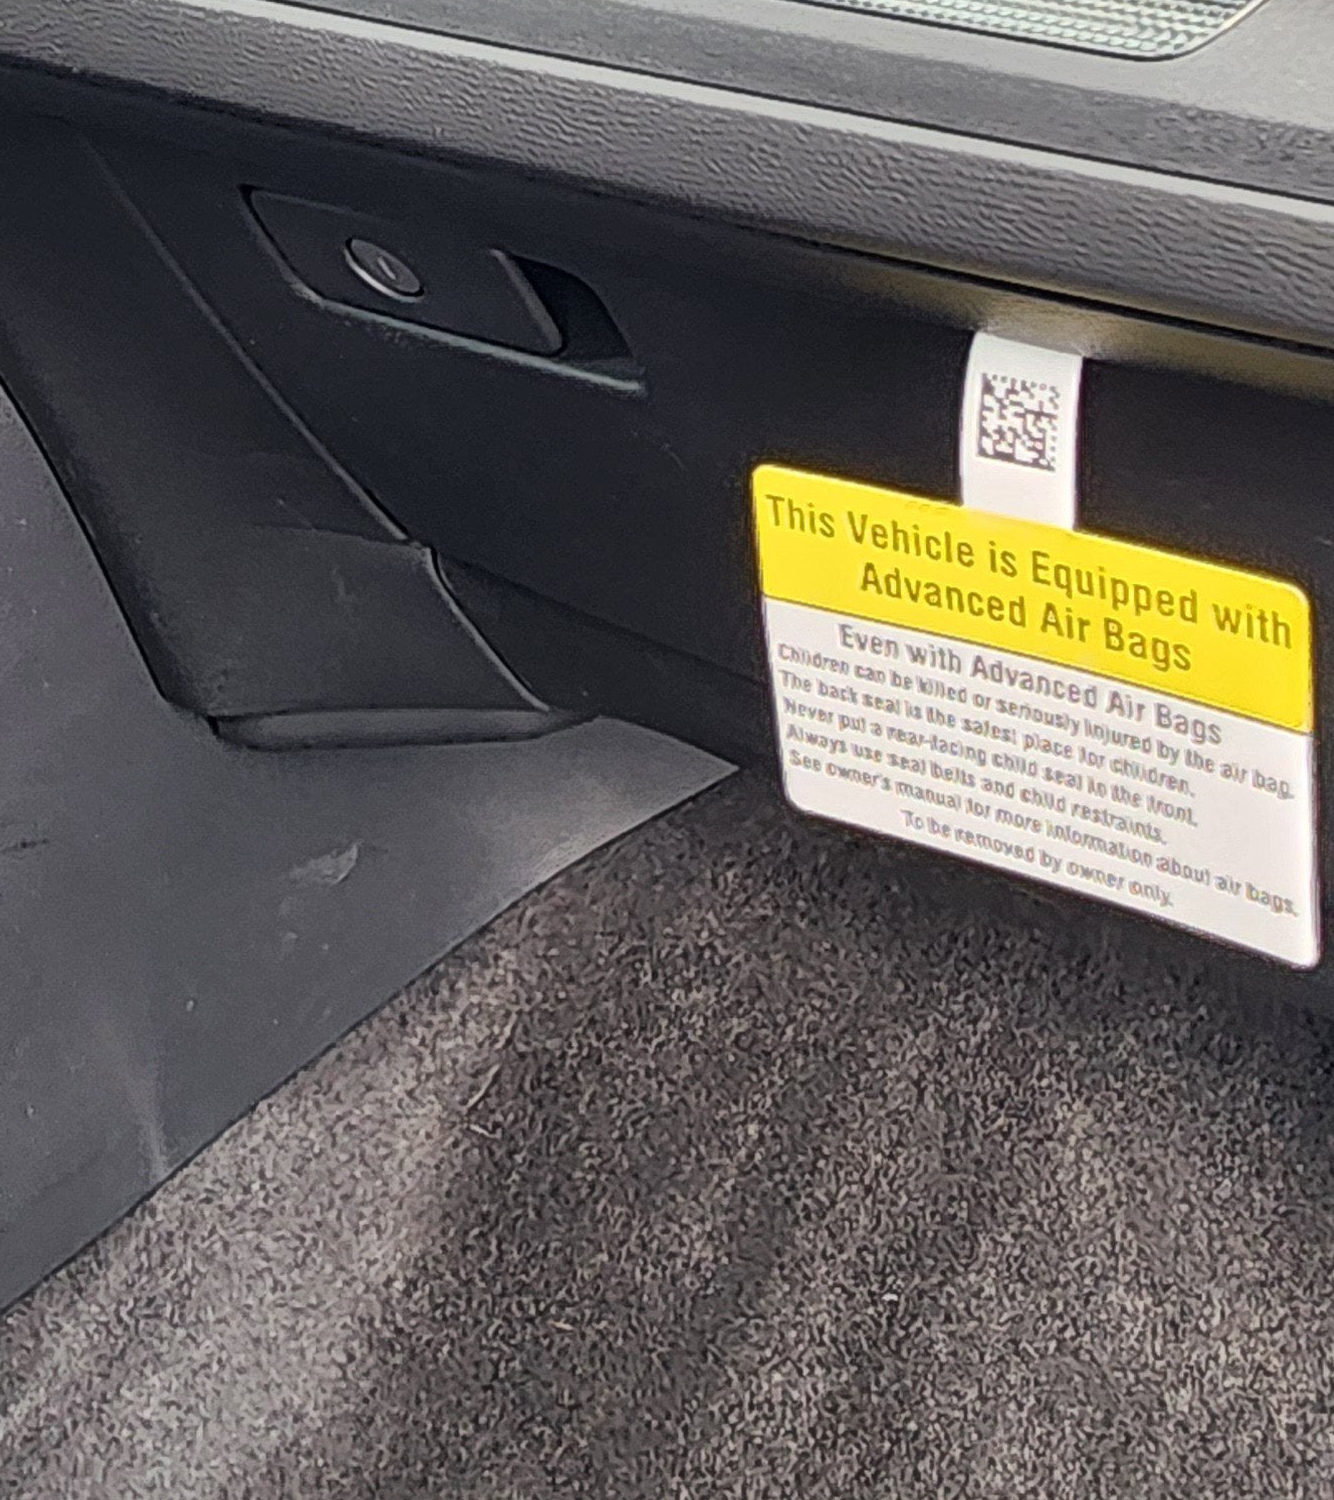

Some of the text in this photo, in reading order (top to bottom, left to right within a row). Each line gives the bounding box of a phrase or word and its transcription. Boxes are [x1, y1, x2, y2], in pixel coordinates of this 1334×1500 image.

[766, 494, 1292, 649] This Vehicle is Equipped with
[861, 562, 1192, 672] Advanced Air Bags
[778, 643, 1295, 801] Children can be killed or seriously injured by the air bag.
[778, 669, 1195, 798] The back seat is the safest place for children.
[838, 623, 1222, 745] Even with Advanced Air Bags
[783, 696, 1198, 827] Never put a rear-facing child seat in the front.
[787, 724, 1168, 845] Always use seat belts and child restraints.
[789, 749, 1300, 917] See owner's manual for more information about air bags.
[900, 809, 1174, 908] To be removed by owner only.
